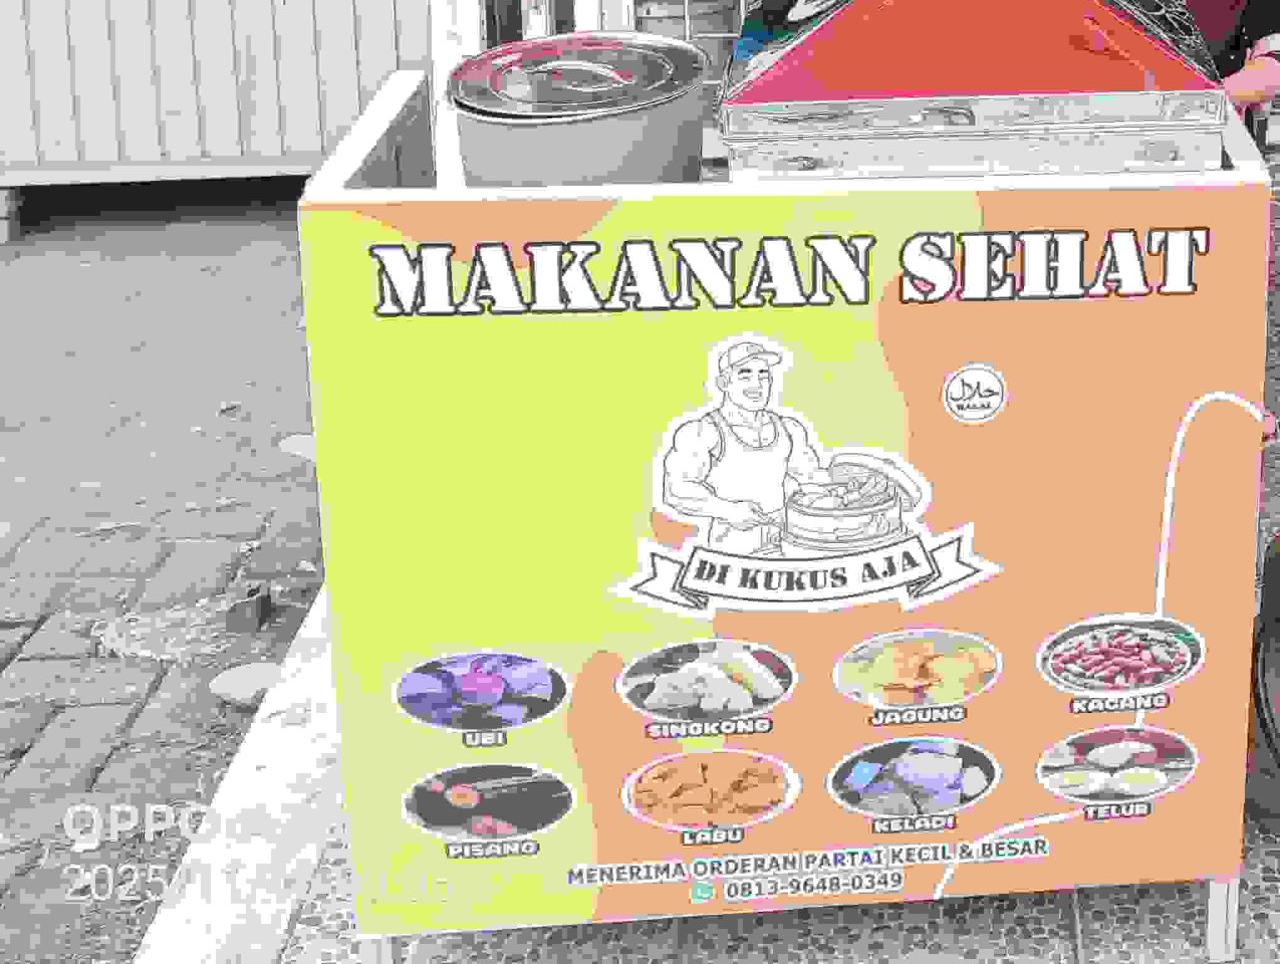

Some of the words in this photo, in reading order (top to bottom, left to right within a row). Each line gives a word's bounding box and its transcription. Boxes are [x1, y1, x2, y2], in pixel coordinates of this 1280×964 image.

[369, 235, 876, 316] MAKANAN
[899, 227, 1210, 304] SEHAT
[694, 559, 731, 585] DI
[738, 565, 848, 591] KUKUS
[861, 549, 920, 583] AJA
[870, 707, 967, 726] JAGUNG
[645, 717, 774, 739] SINGKONG
[462, 731, 508, 748] UBI
[1084, 803, 1152, 821] TELUR
[872, 815, 958, 833] KELADI
[681, 828, 744, 845] LABU
[445, 840, 540, 859] PISANG
[568, 862, 687, 884] MENERIMA
[692, 853, 797, 877] ORDERAN
[804, 849, 882, 869] PARTAI
[891, 844, 953, 864] KECIL
[959, 844, 974, 859] &
[981, 838, 1048, 857] BESAR
[726, 872, 903, 898] 0813-9648-0349
